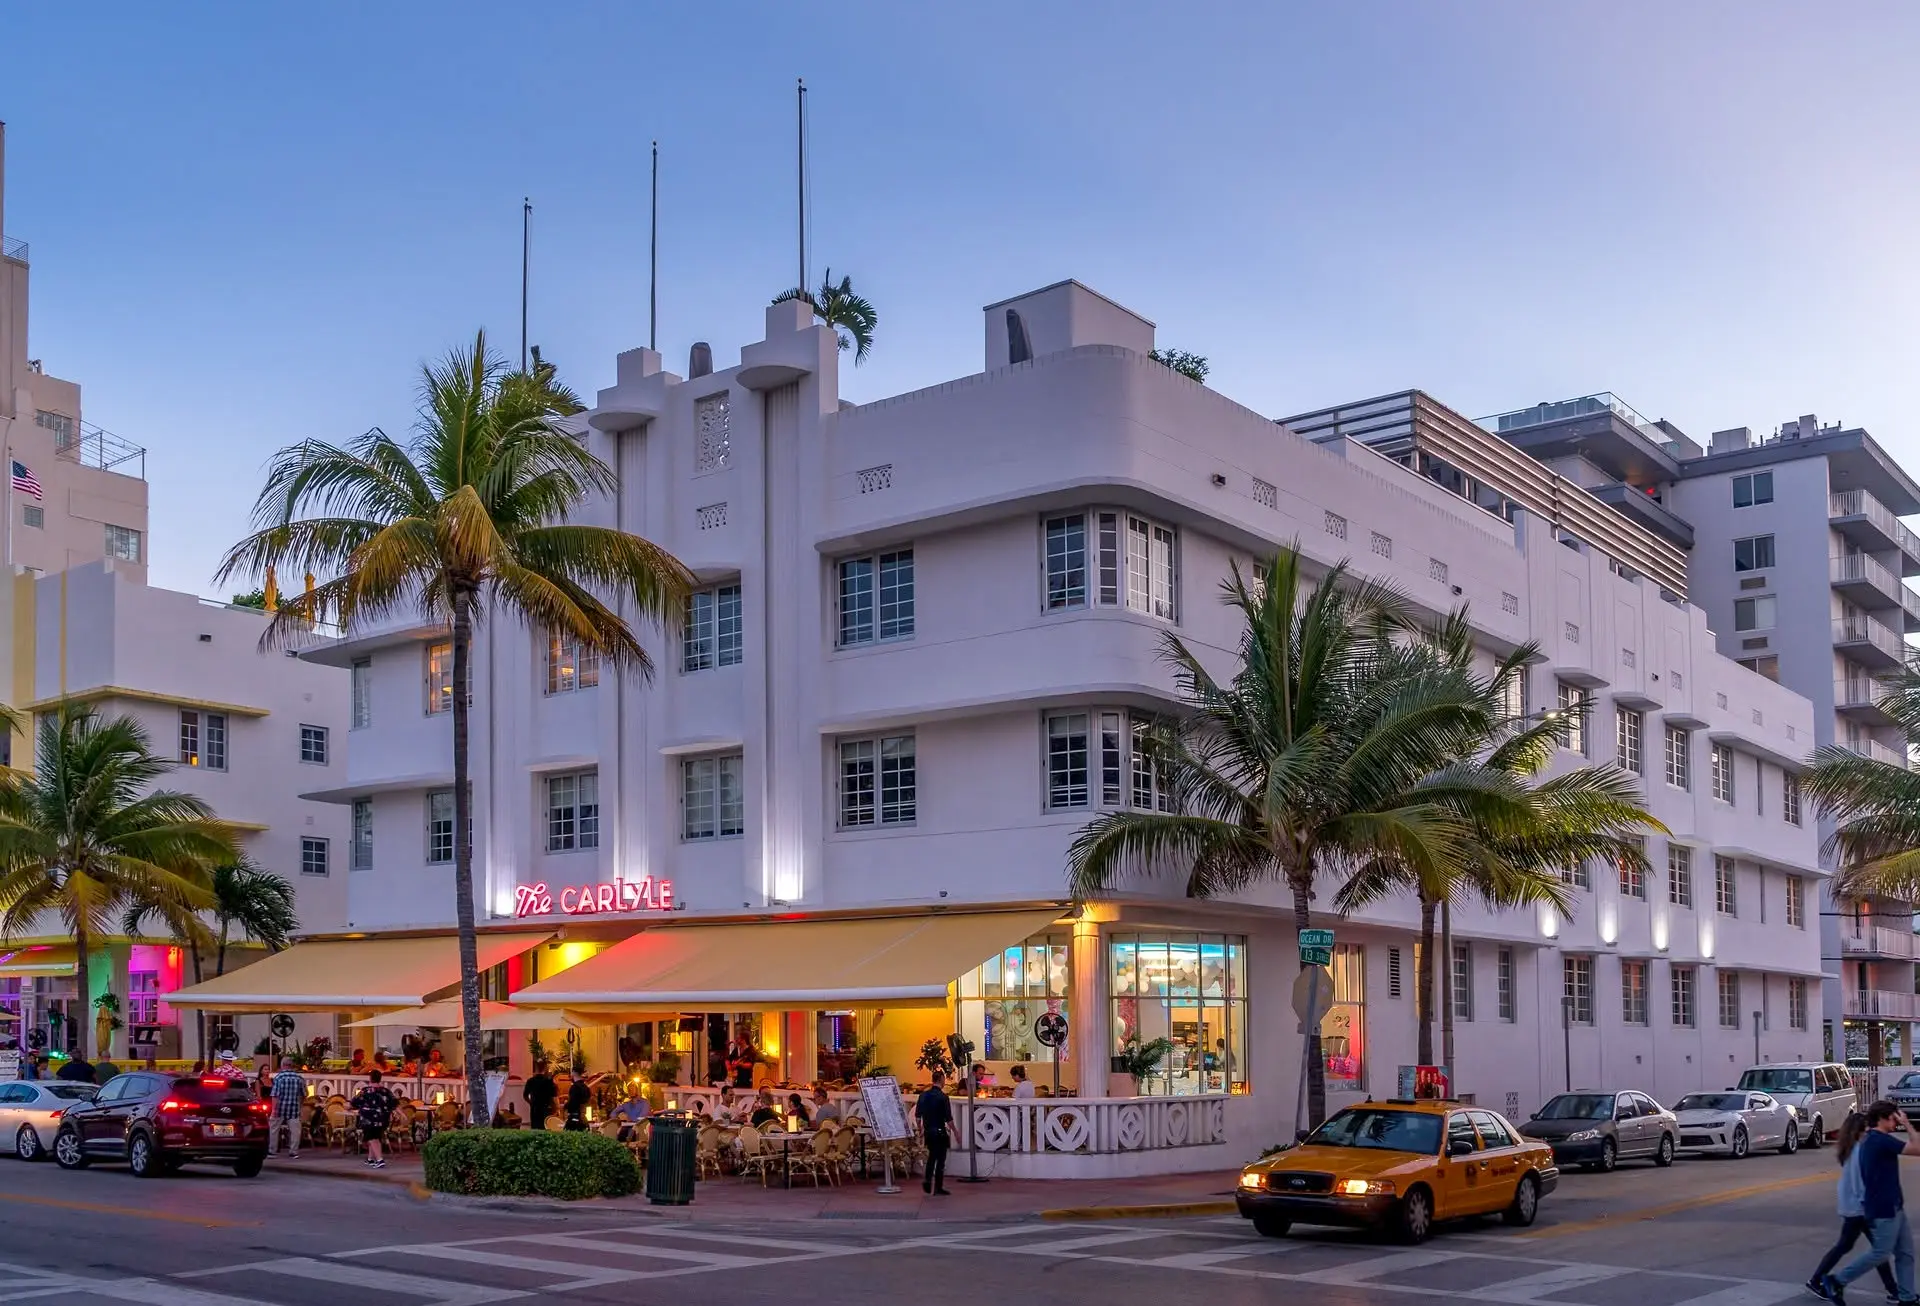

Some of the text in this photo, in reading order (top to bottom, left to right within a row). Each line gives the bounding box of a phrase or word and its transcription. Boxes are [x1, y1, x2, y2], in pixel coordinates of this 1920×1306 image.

[515, 875, 673, 917] The CARLYLE
[1301, 934, 1332, 944] OCEAN DR
[1305, 949, 1313, 961] 13
[862, 1078, 893, 1087] HAPPY HOUR
